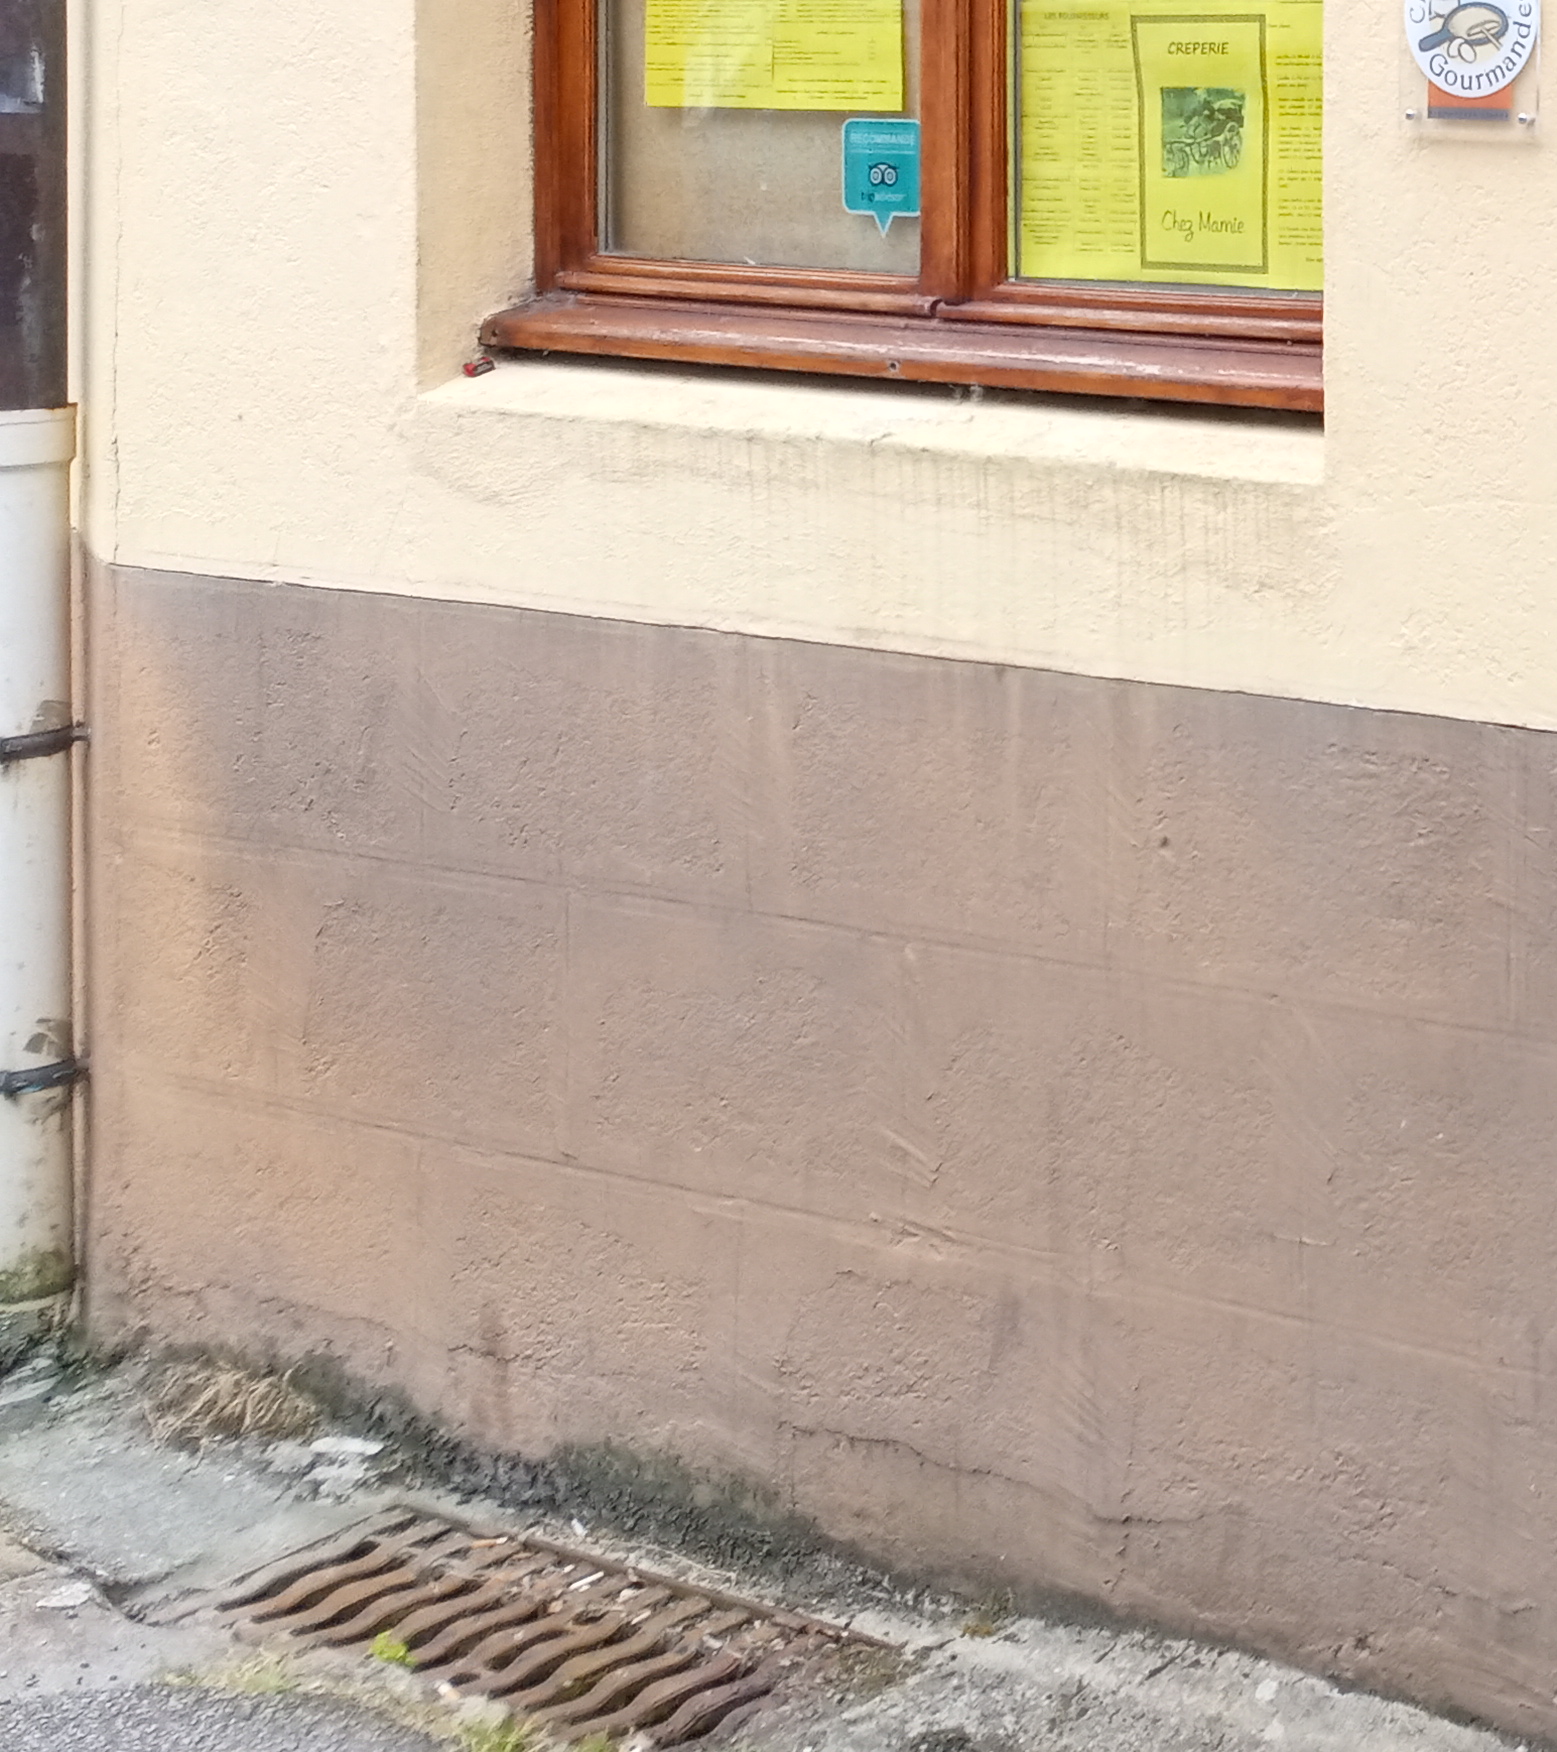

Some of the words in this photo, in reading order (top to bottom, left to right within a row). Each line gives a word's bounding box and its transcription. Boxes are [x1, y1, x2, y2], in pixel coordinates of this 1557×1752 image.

[1168, 42, 1229, 54] CREPERIE
[1161, 210, 1193, 242] Chez
[1199, 211, 1244, 234] Mamie
